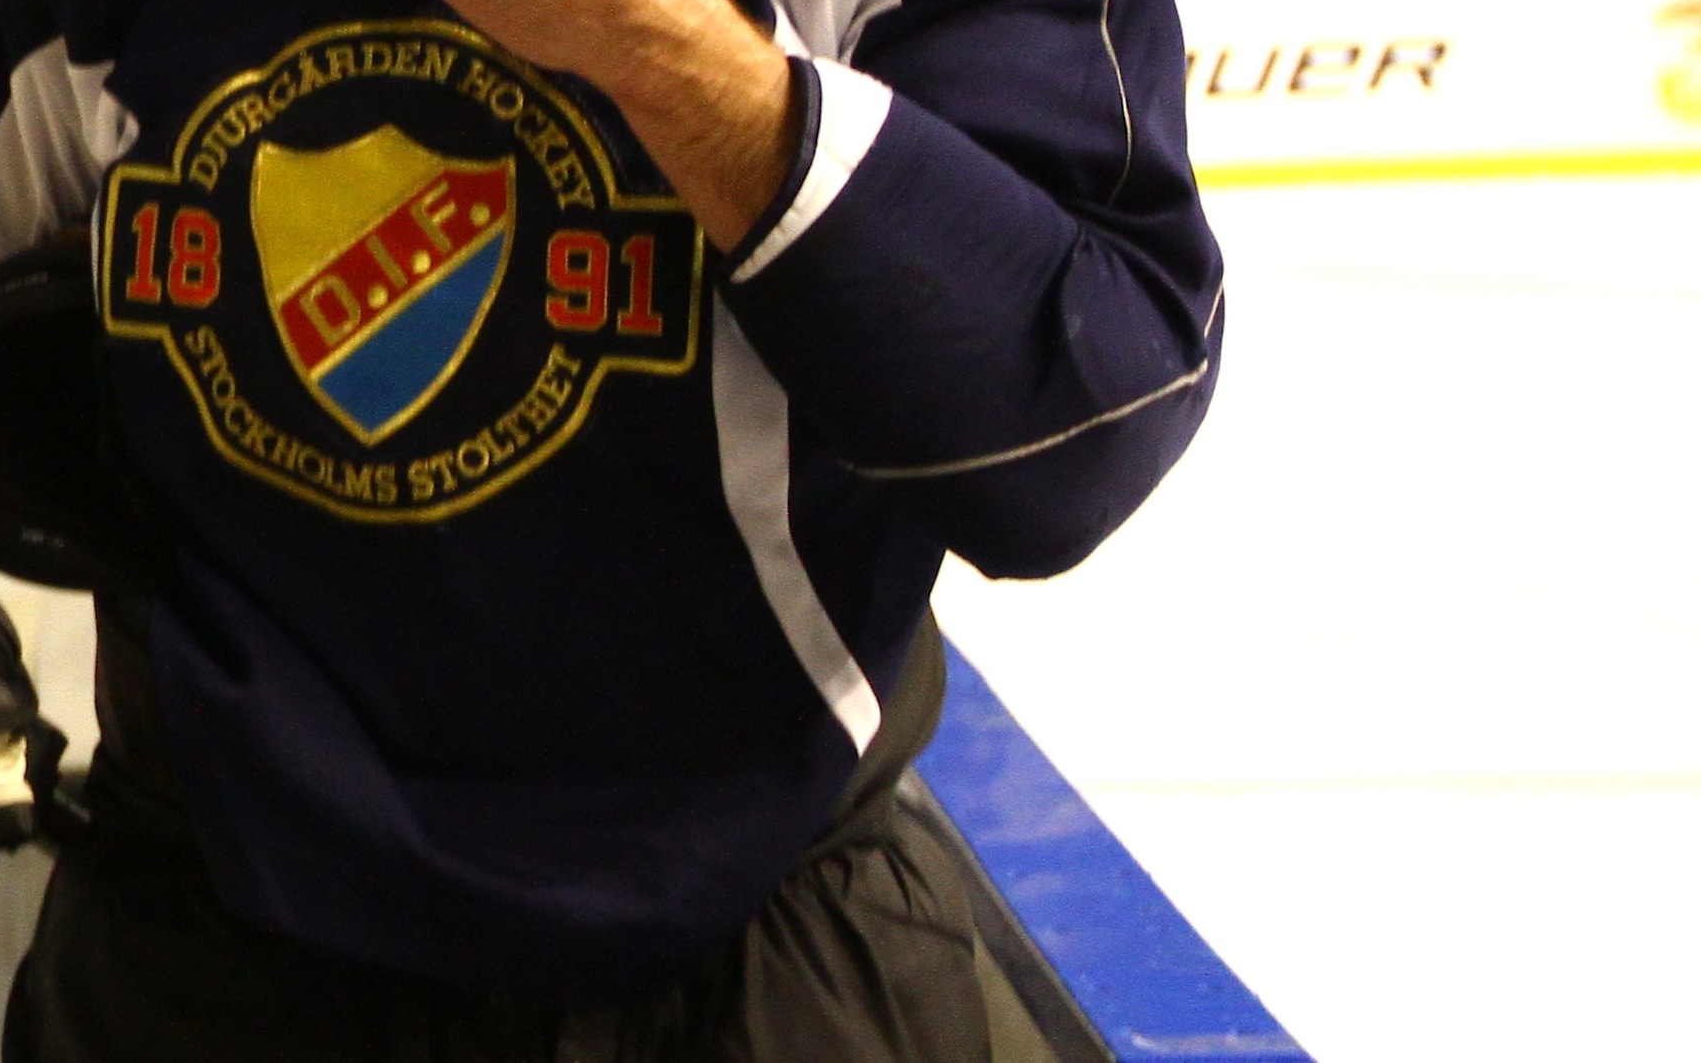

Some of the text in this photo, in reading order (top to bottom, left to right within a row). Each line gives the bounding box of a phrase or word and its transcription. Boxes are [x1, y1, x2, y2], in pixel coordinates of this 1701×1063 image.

[1185, 42, 1447, 95] UER
[188, 40, 596, 211] DJURGÅRDEN HOCKEY
[126, 201, 221, 308] 18
[545, 229, 664, 336] 91
[185, 325, 581, 504] STOCKHOLMS STOLTHET
